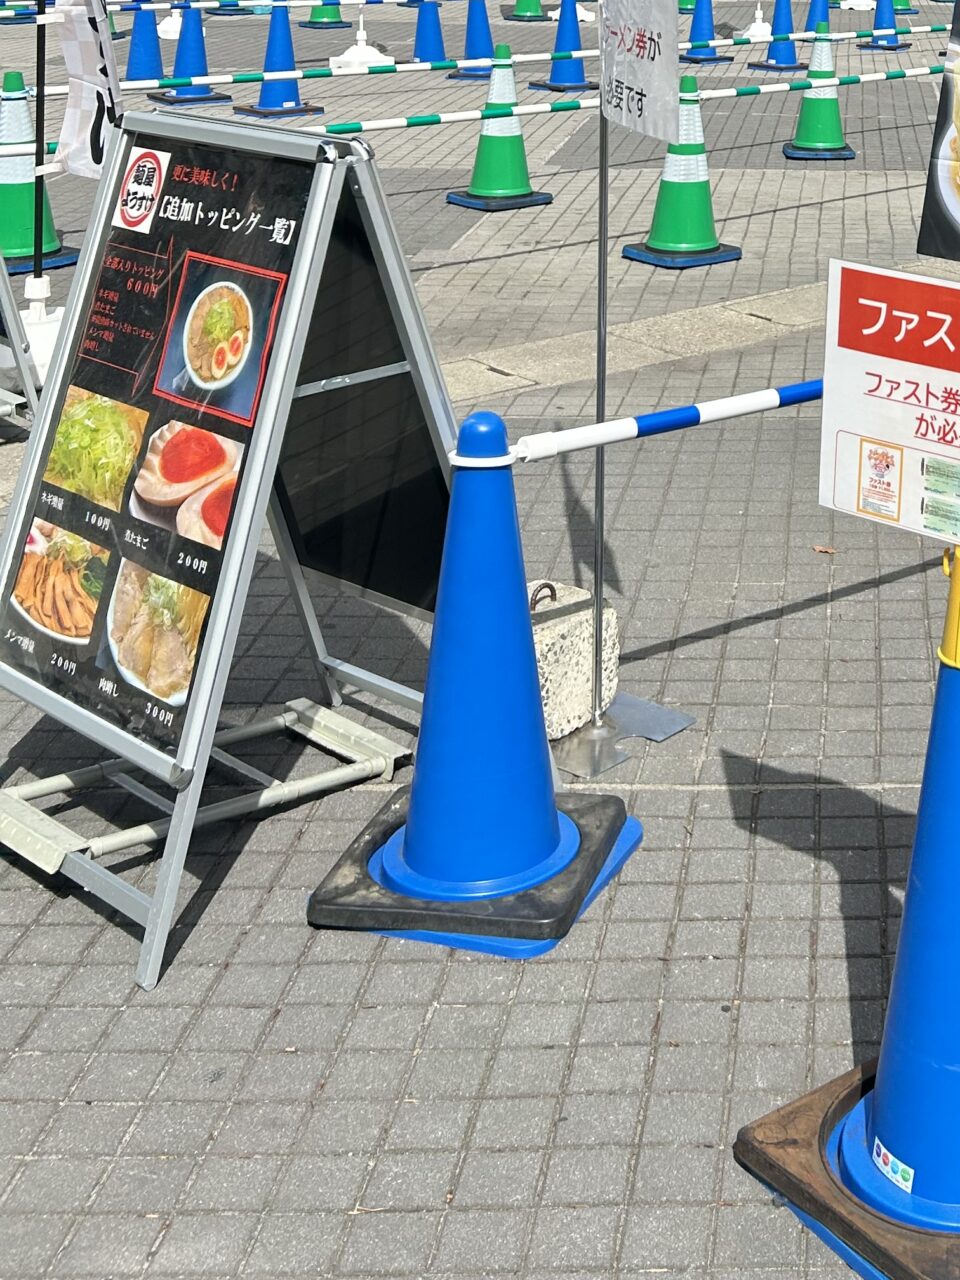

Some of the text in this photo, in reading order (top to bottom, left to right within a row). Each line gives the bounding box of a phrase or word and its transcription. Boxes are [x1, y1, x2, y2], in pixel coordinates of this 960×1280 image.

[132, 164, 156, 188] 麺屋
[158, 195, 297, 246] 【追加トッピング一覧】
[177, 552, 208, 574] 200円
[50, 653, 77, 676] 200円
[145, 702, 174, 727] 300円
